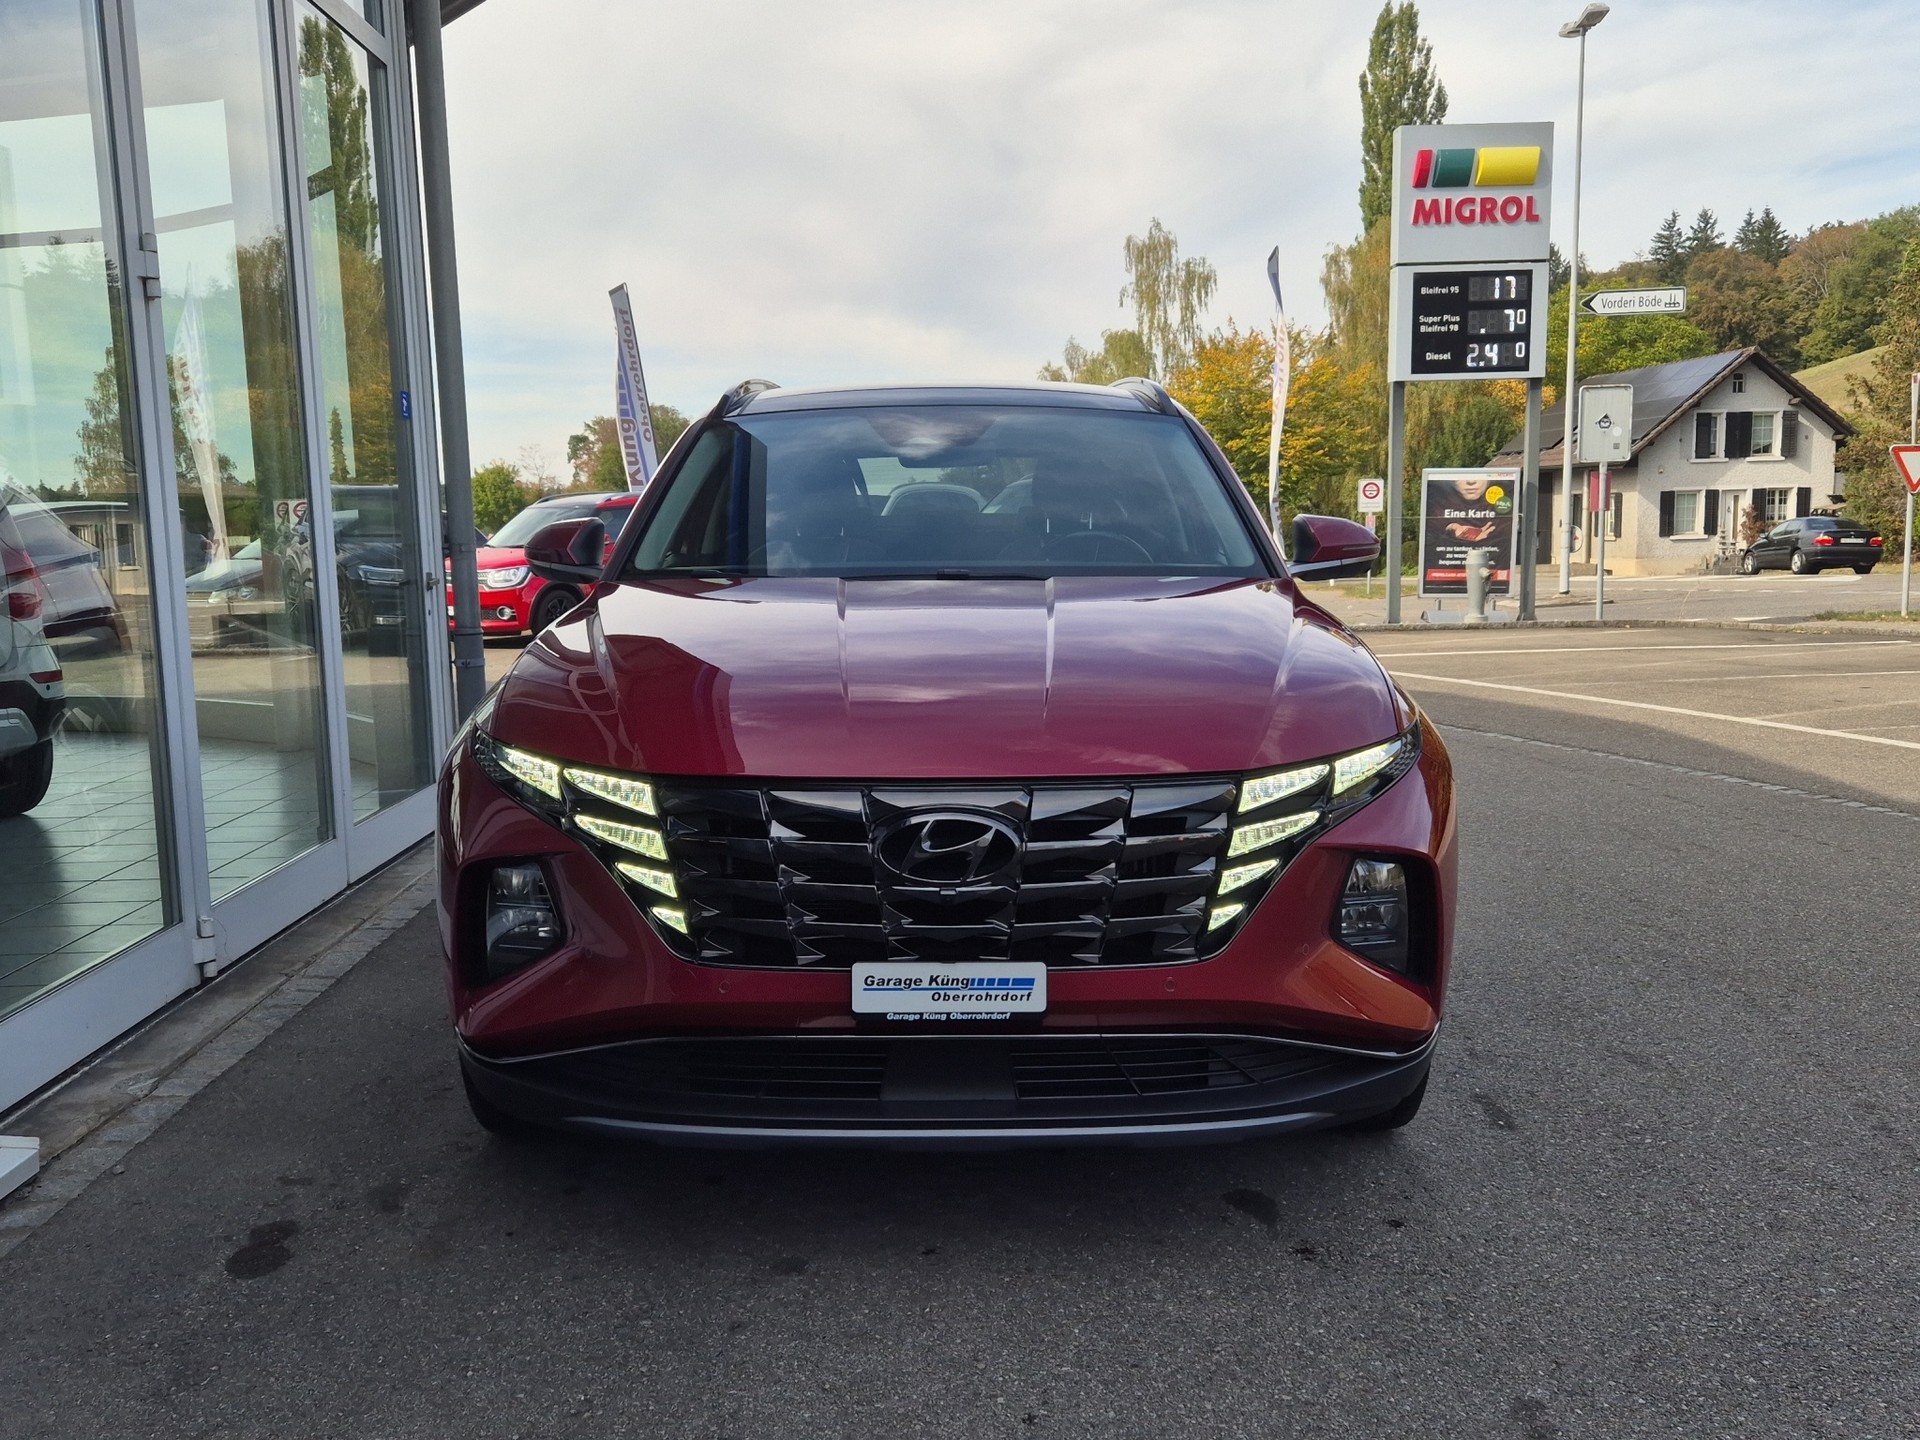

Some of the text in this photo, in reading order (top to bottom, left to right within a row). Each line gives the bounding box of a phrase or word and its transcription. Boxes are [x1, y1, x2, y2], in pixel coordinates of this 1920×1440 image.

[1411, 195, 1540, 225] MIGROL
[1420, 285, 1460, 295] Bleifrei 95
[1601, 294, 1663, 309] Vorderi Böde
[1419, 314, 1460, 324] Super Plus
[1420, 324, 1459, 333] Bleifrei 98
[1425, 352, 1451, 361] Diesel
[1444, 508, 1496, 518] Eine Karte
[863, 974, 971, 990] Garage Küng
[931, 991, 1033, 1002] Oberrohrdorf
[886, 1011, 1011, 1021] Garage Küng Oberrohrdorf
